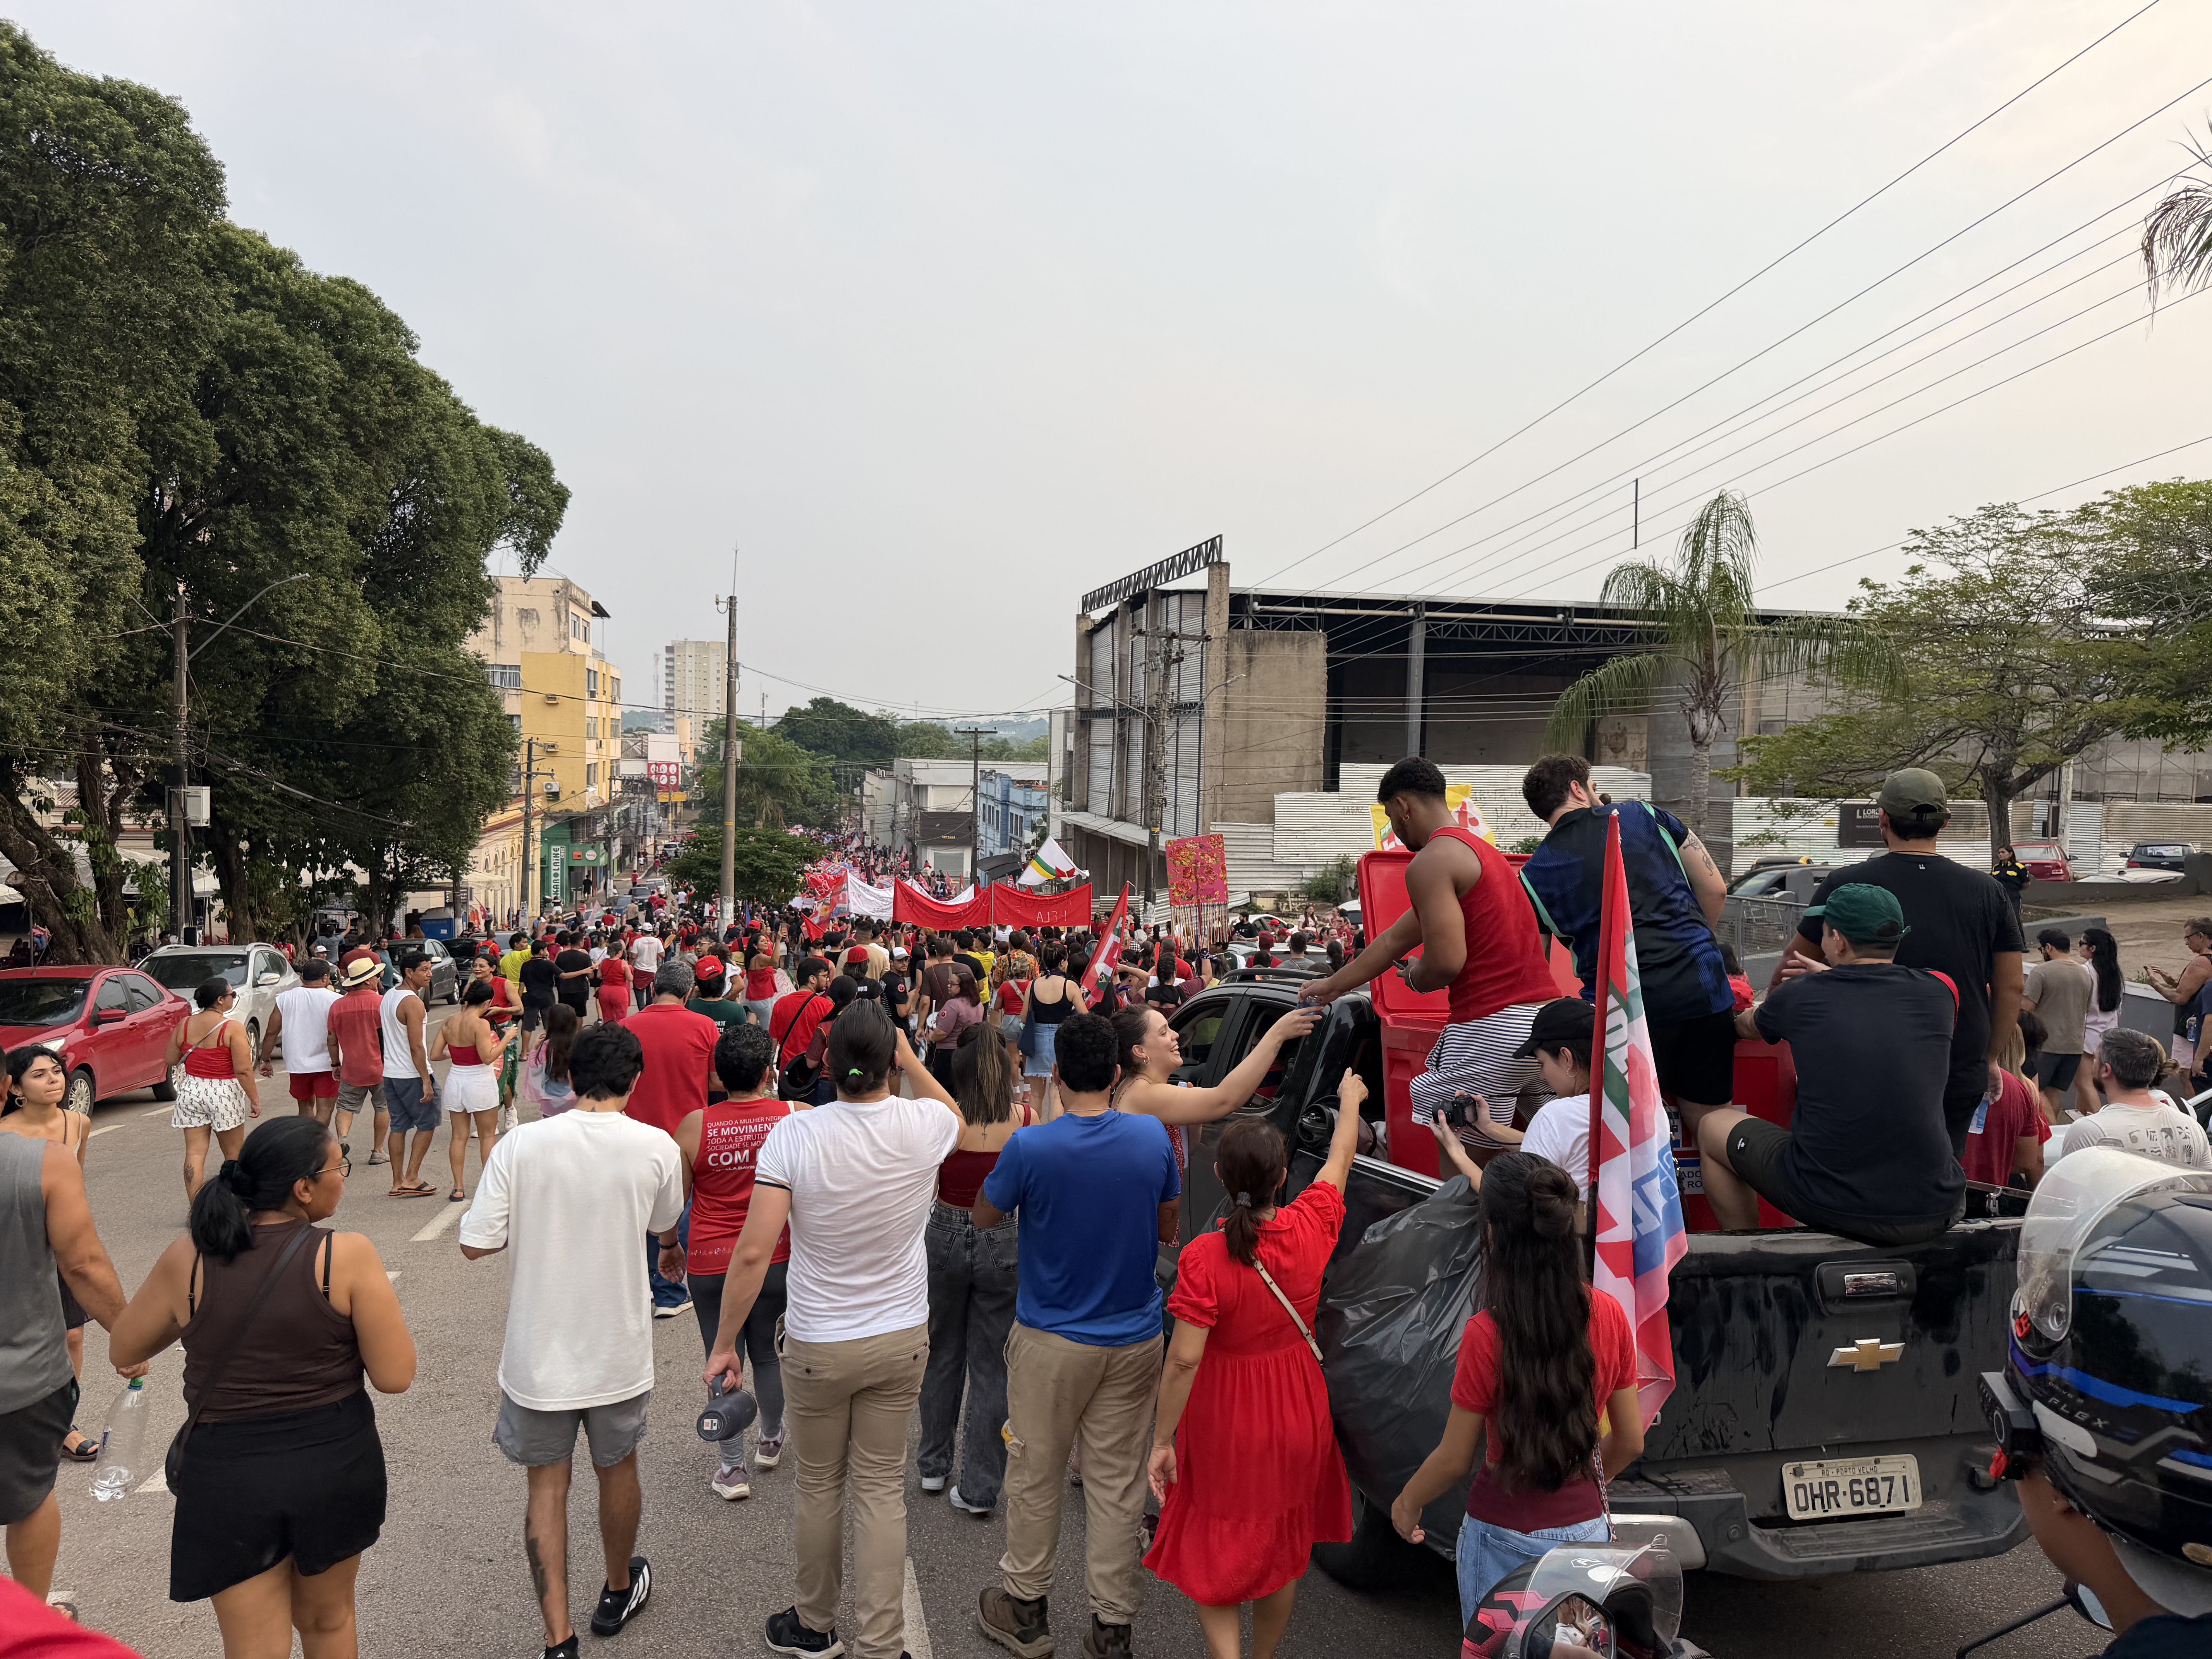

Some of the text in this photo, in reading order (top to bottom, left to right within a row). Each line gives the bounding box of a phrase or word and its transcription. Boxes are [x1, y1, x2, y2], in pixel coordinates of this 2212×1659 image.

[707, 1120, 733, 1128] QUANDO
[708, 1122, 778, 1137] SE MOVIMENT
[707, 1143, 741, 1151] SOCIEDADE
[708, 1149, 749, 1166] COM
[1858, 1466, 1878, 1474] VELHO
